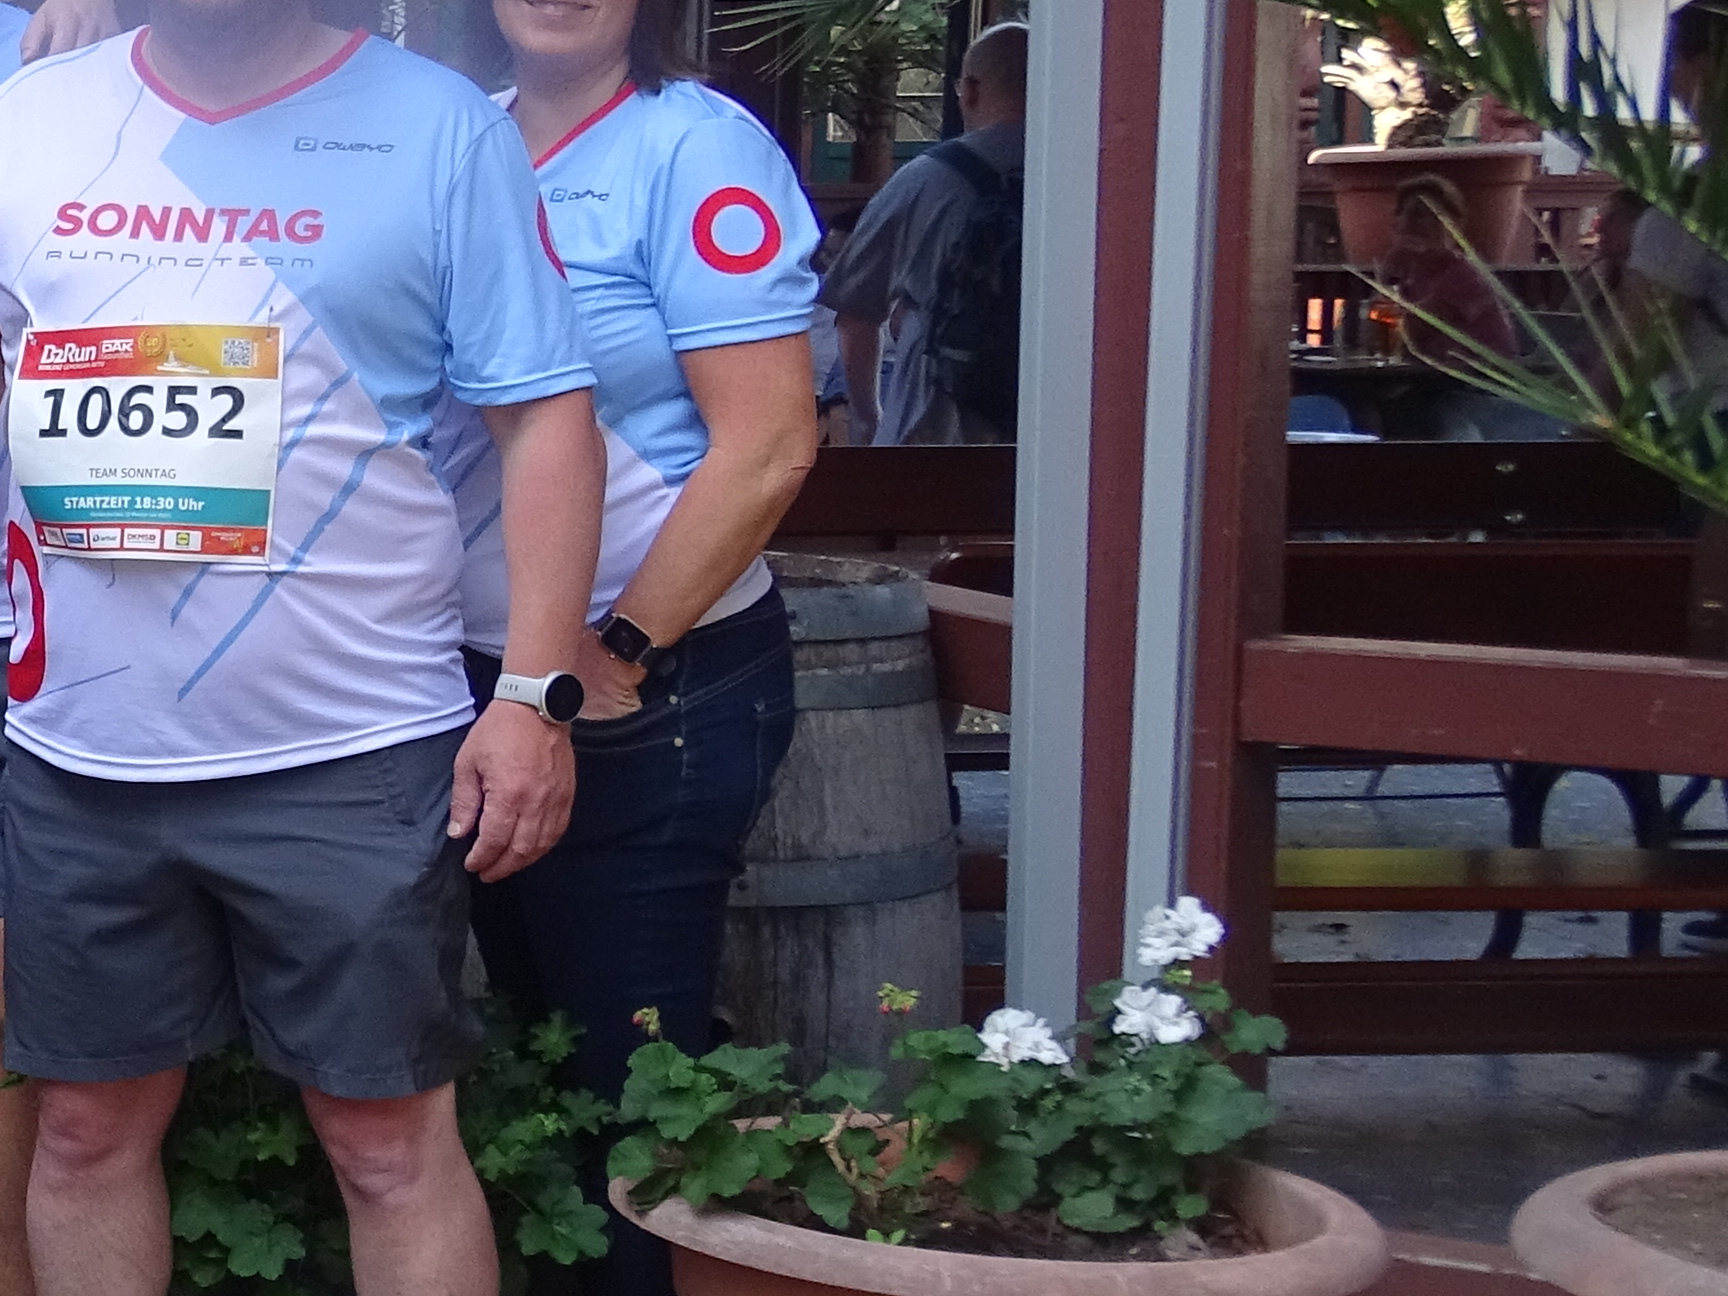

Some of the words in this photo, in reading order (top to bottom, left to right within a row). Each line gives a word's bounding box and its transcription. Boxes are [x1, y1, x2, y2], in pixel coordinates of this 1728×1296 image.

[51, 201, 326, 245] SONNTAG
[38, 384, 245, 440] 10652
[88, 467, 117, 478] TEAM
[120, 467, 177, 480] SONNTAG
[64, 496, 131, 510] STARTZEIT
[134, 496, 174, 510] 18:30
[178, 497, 206, 511] Uhr
